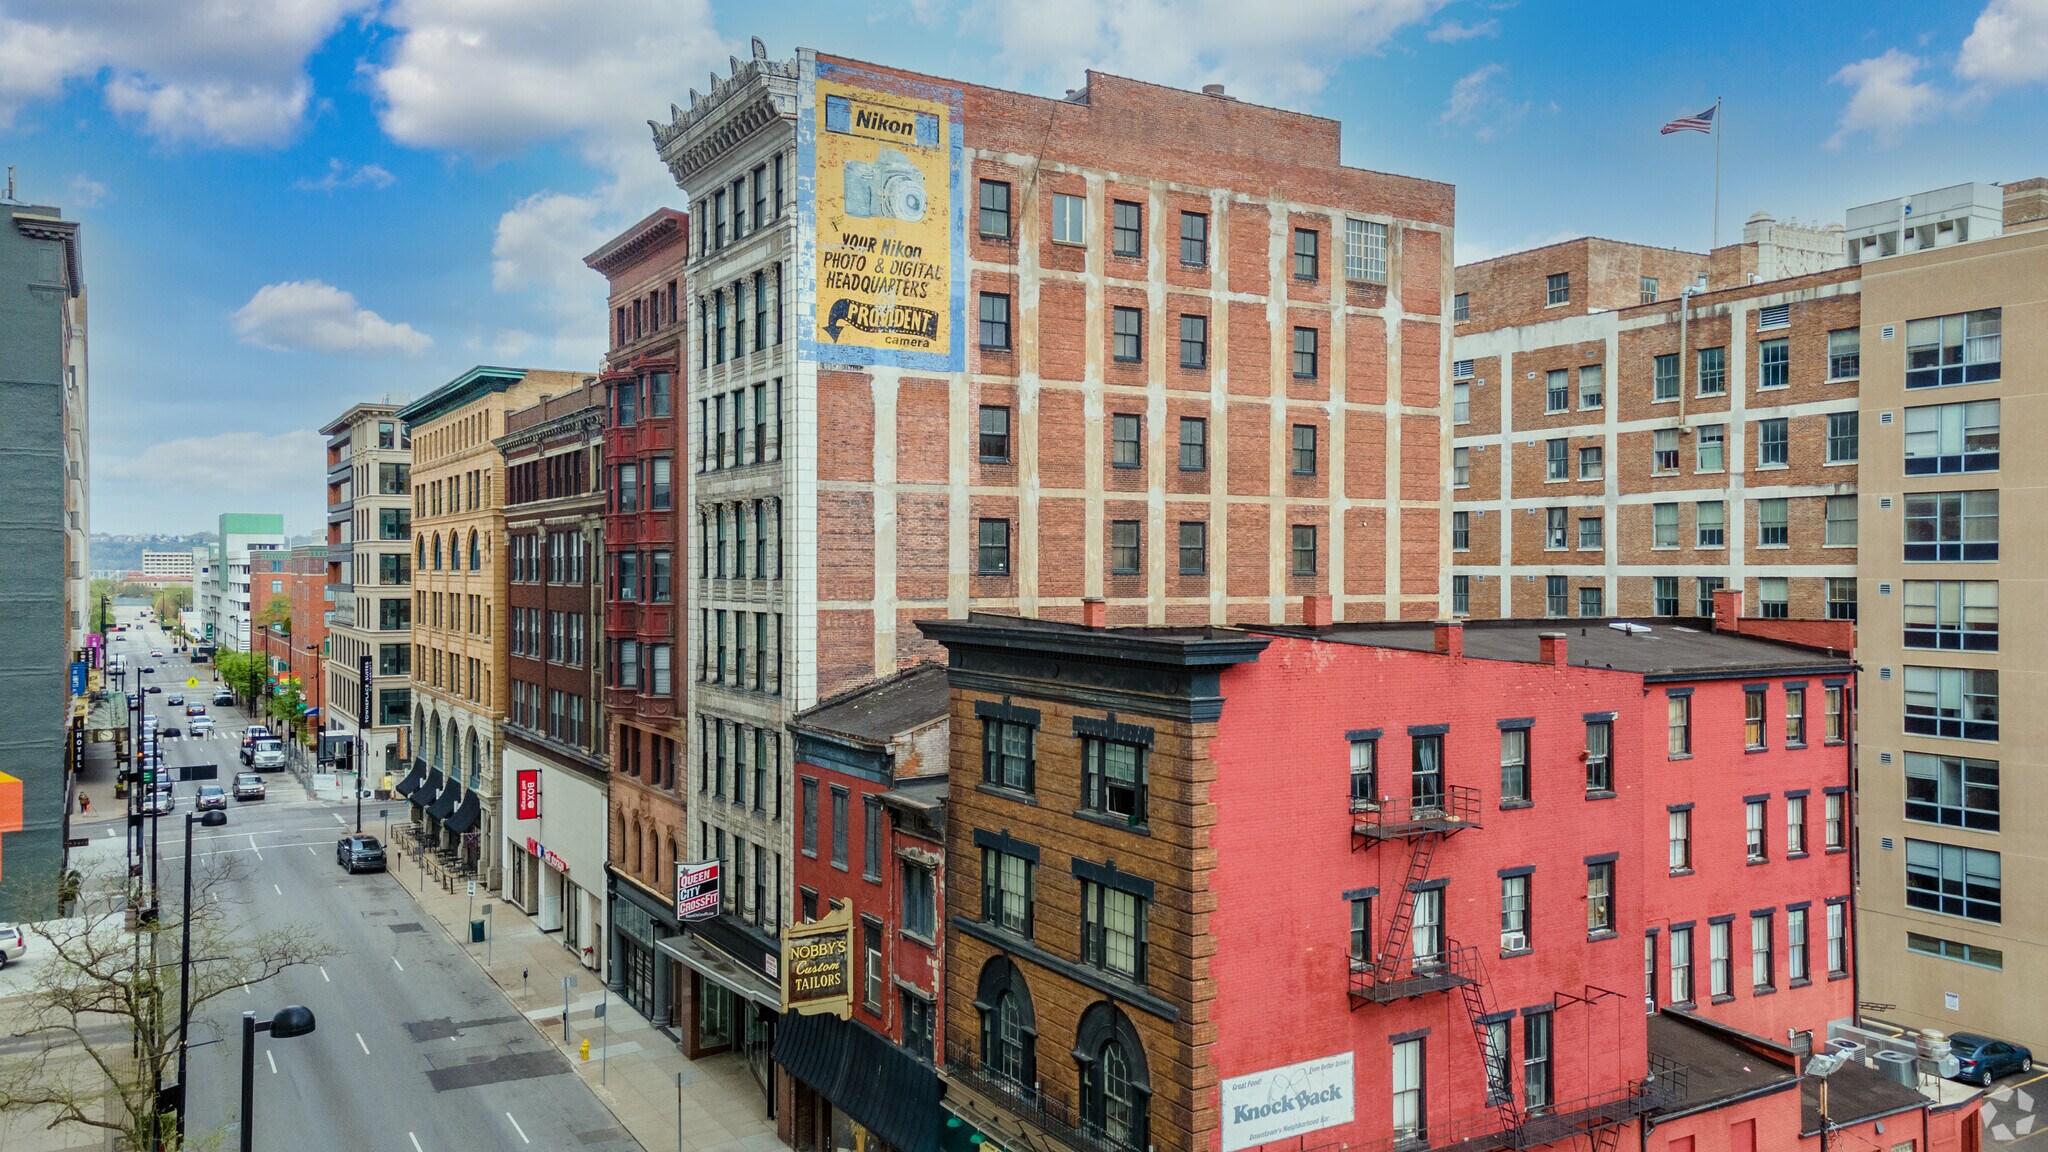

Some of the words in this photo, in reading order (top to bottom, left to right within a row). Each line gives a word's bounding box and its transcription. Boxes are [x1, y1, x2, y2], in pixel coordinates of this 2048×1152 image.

[856, 110, 914, 136] Nikon
[841, 233, 877, 253] YOUR
[880, 238, 922, 259] Nikon
[823, 251, 867, 272] PHOTO
[874, 257, 885, 274] &
[889, 260, 943, 280] DIGITAL
[826, 271, 929, 299] HEADQUARTERS
[847, 303, 933, 333] PROVIDENT
[885, 336, 930, 348] camera
[527, 782, 535, 801] BOX
[680, 869, 711, 889] QUEEN
[680, 885, 701, 901] CITY
[790, 940, 846, 960] NOBBY'S
[796, 960, 840, 975] Custom
[795, 972, 841, 991] TAILORS
[1232, 1082, 1247, 1091] Great
[1283, 1117, 1320, 1132] Neighborhood
